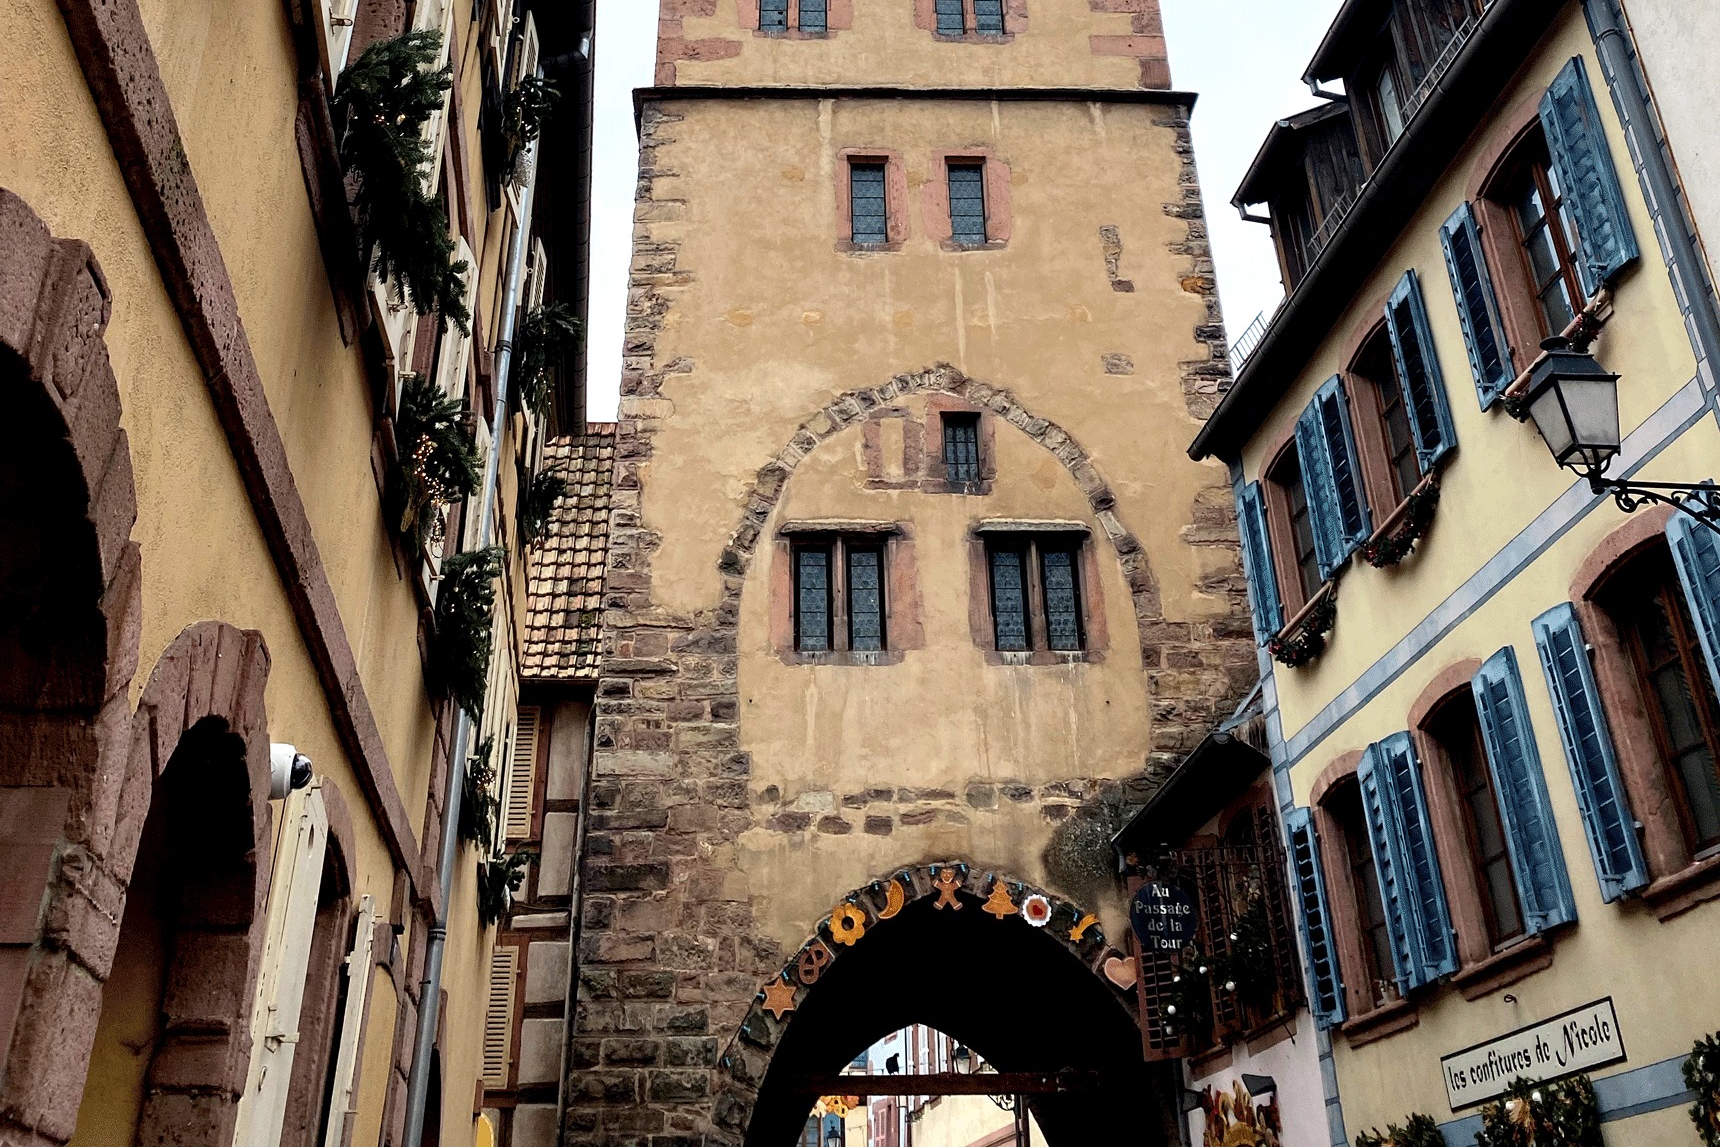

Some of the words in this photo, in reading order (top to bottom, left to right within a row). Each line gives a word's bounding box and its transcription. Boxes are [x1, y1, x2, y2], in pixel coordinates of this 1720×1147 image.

[1152, 884, 1169, 897] Au
[1134, 901, 1190, 917] Passage
[1148, 919, 1163, 931] de
[1170, 919, 1182, 931] la
[1150, 936, 1182, 948] Tour
[1448, 1066, 1466, 1092] les
[1470, 1048, 1532, 1084] confitures
[1535, 1034, 1550, 1064] de
[1555, 1014, 1610, 1067] Nicole
